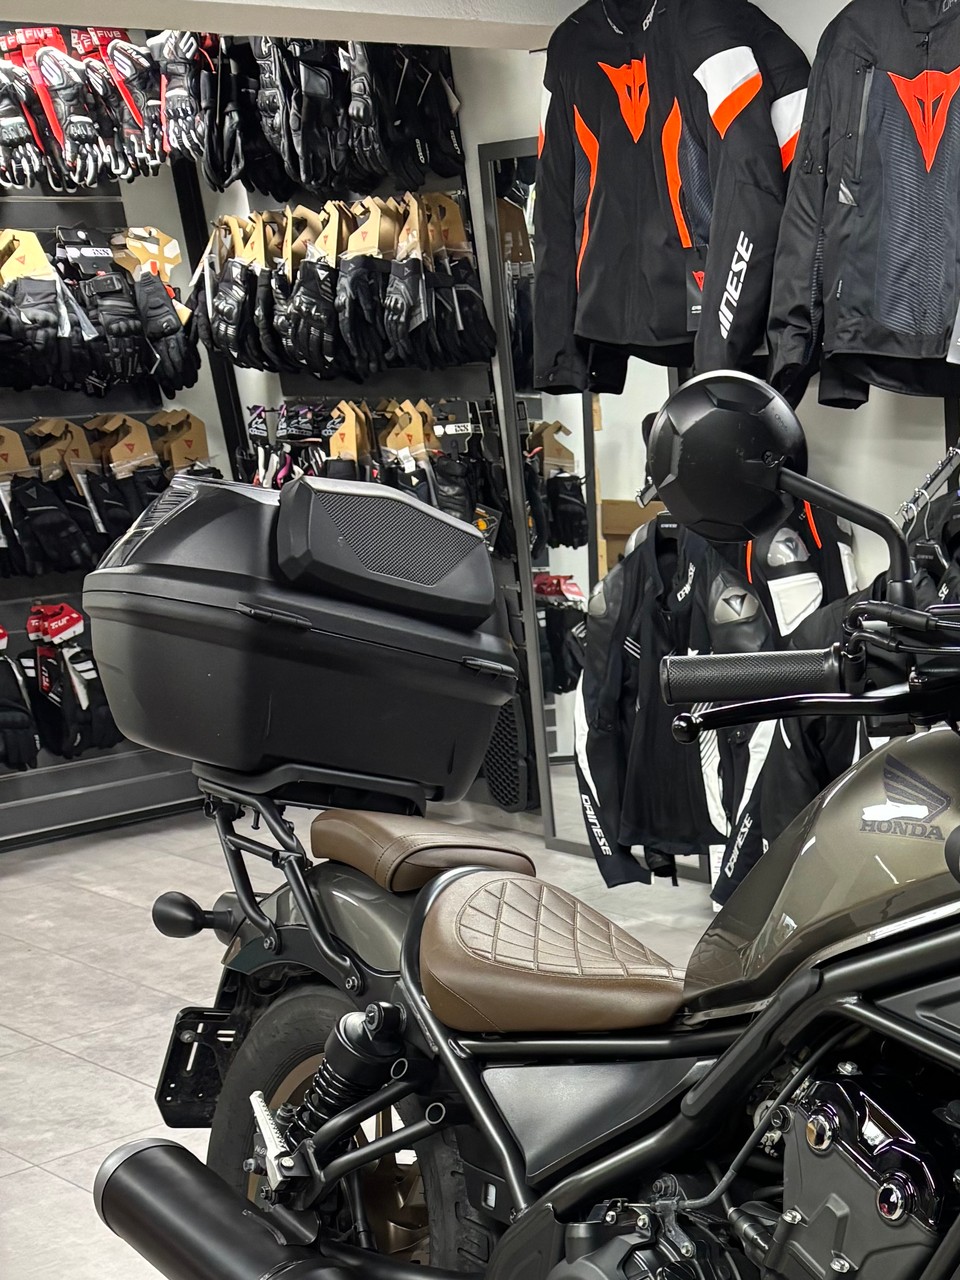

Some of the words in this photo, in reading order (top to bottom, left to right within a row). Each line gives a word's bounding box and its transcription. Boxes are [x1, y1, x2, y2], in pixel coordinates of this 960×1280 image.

[581, 794, 613, 857] DAINESE
[725, 813, 753, 878] DAINESE
[859, 819, 945, 841] HONDA
